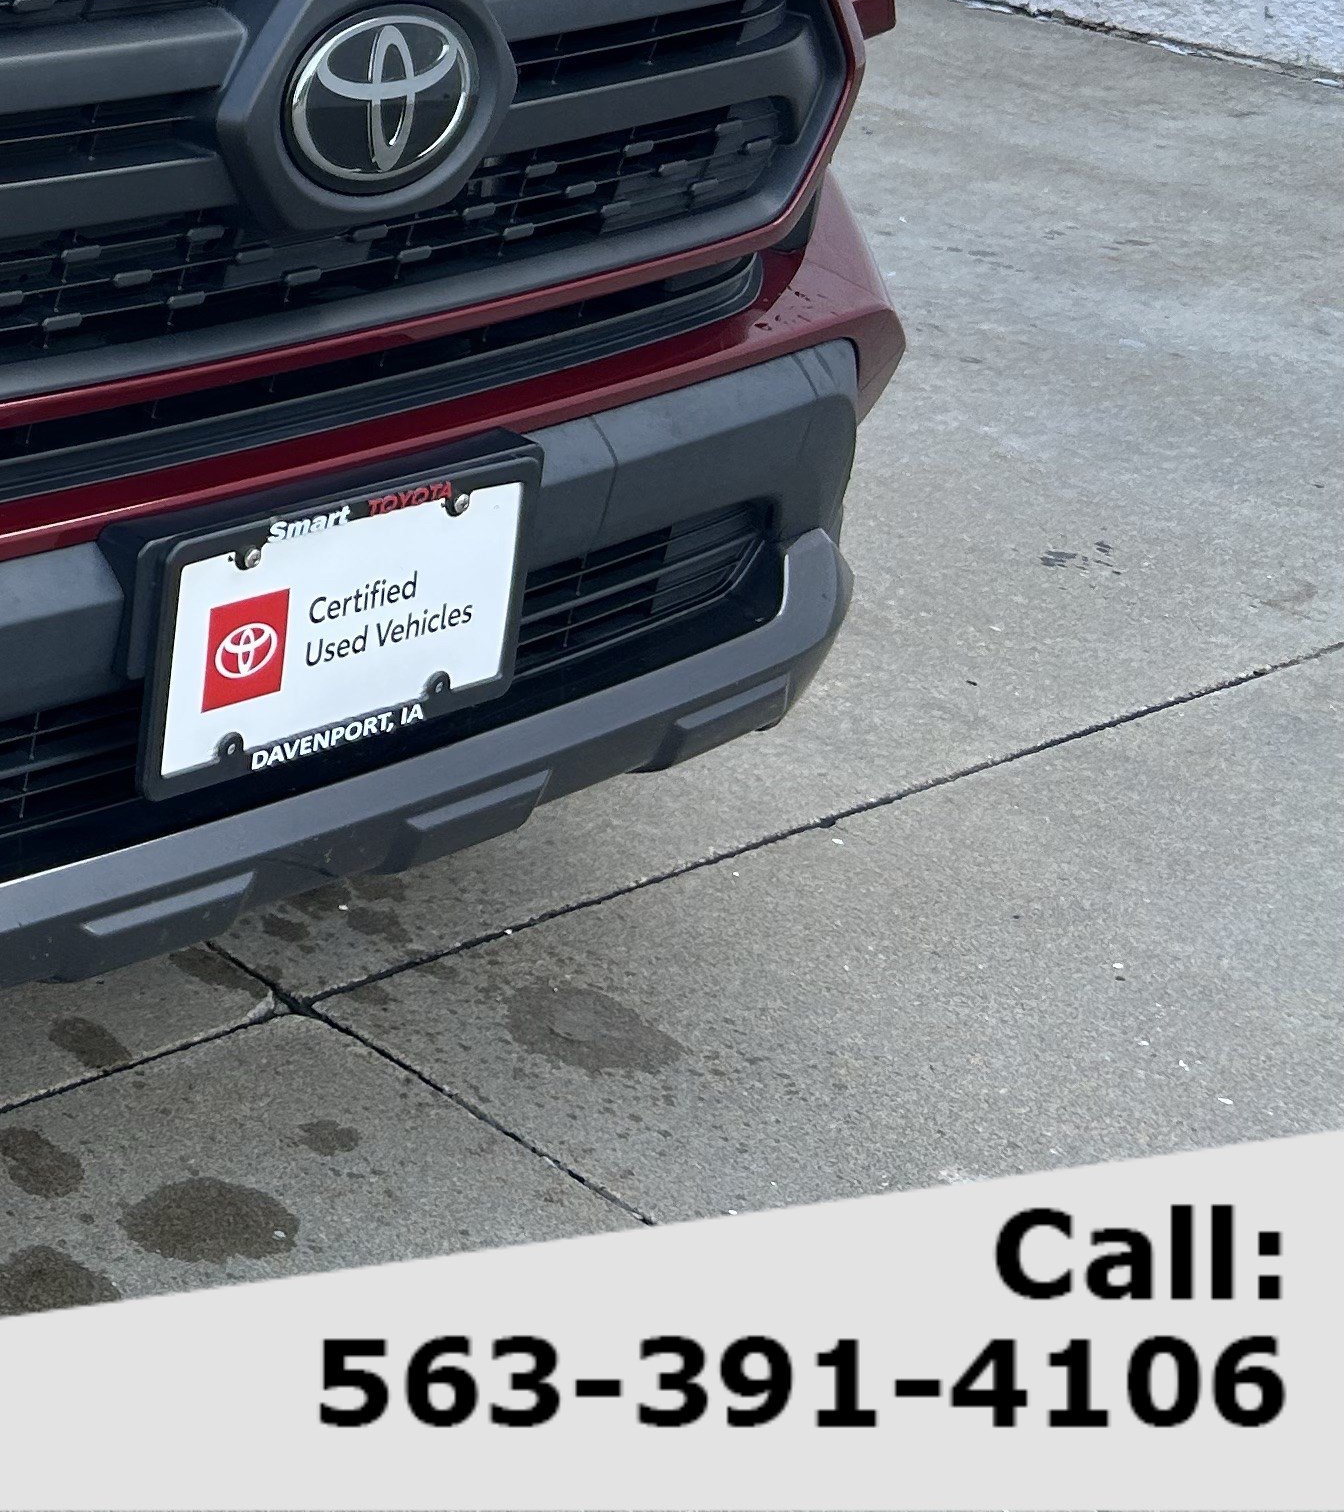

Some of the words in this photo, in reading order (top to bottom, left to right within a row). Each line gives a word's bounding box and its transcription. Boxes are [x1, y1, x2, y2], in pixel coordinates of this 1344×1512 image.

[267, 505, 351, 543] Smart
[367, 481, 453, 518] TOYOTA
[309, 570, 418, 624] Certified
[305, 624, 367, 667] Used
[375, 602, 473, 648] Vehicles
[250, 709, 395, 771] DAVENPORT,
[399, 702, 425, 724] IA
